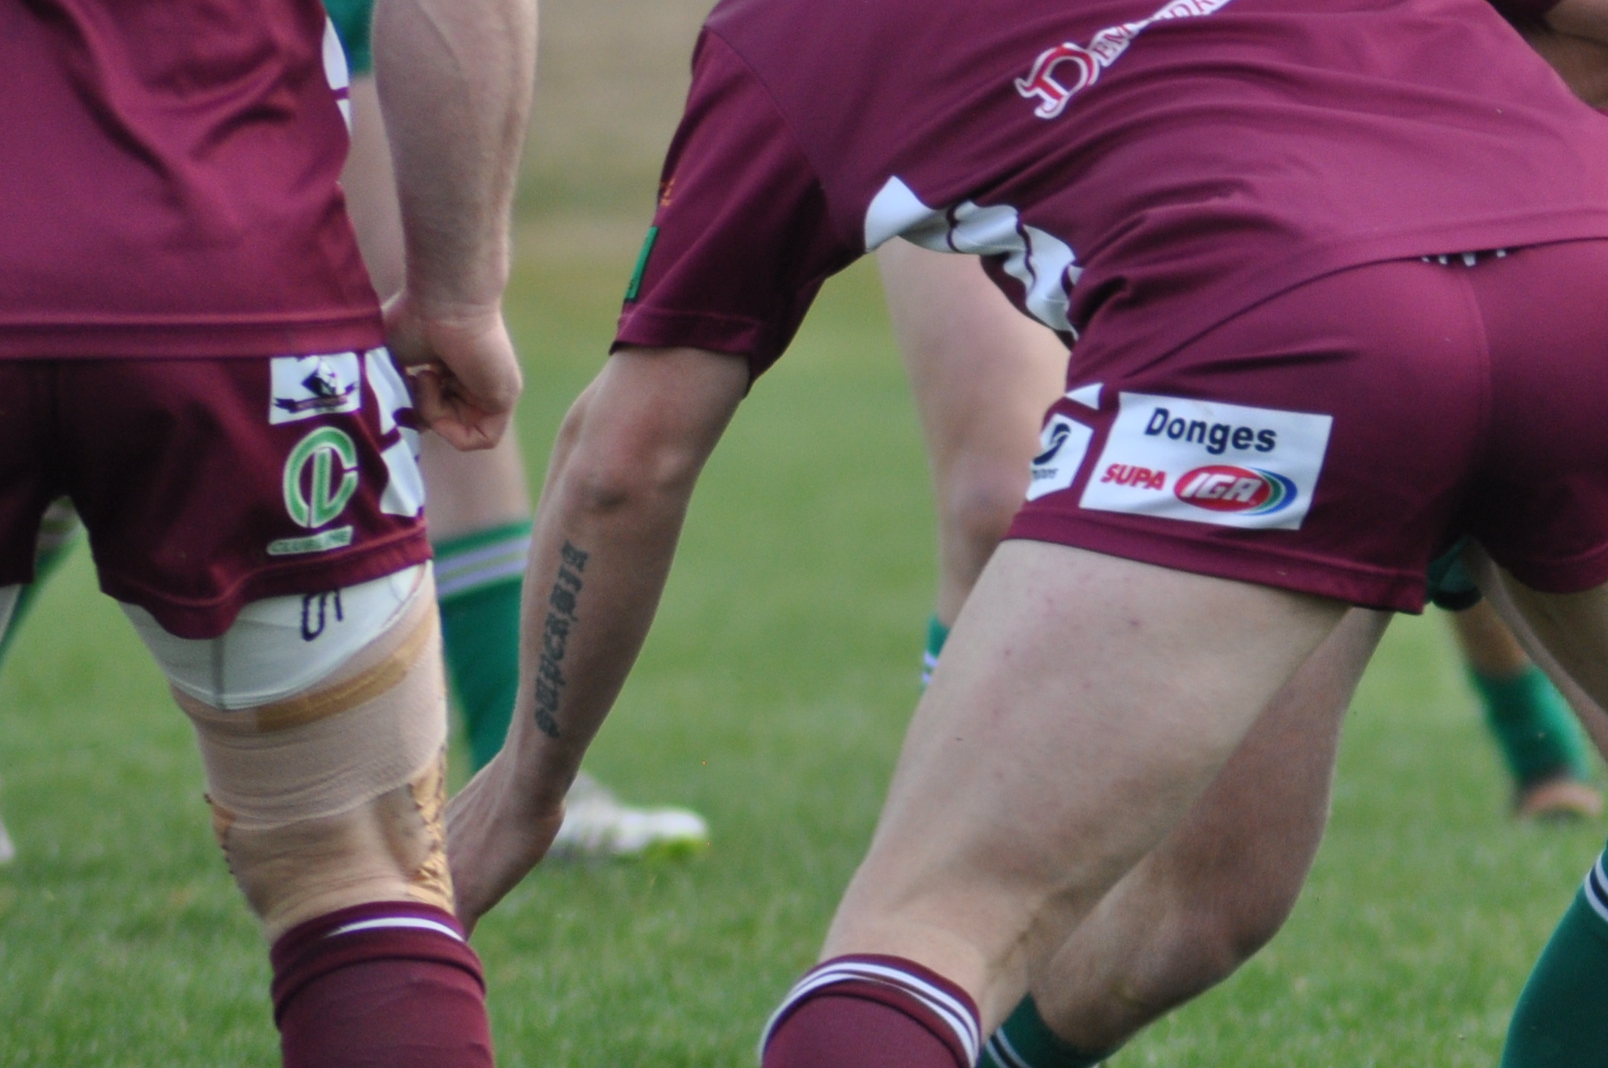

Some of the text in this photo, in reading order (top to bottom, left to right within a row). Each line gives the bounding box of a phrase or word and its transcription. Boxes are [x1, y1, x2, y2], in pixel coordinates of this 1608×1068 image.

[1144, 407, 1278, 456] Donges
[1101, 462, 1167, 492] SUPA
[1180, 472, 1262, 504] IGA
